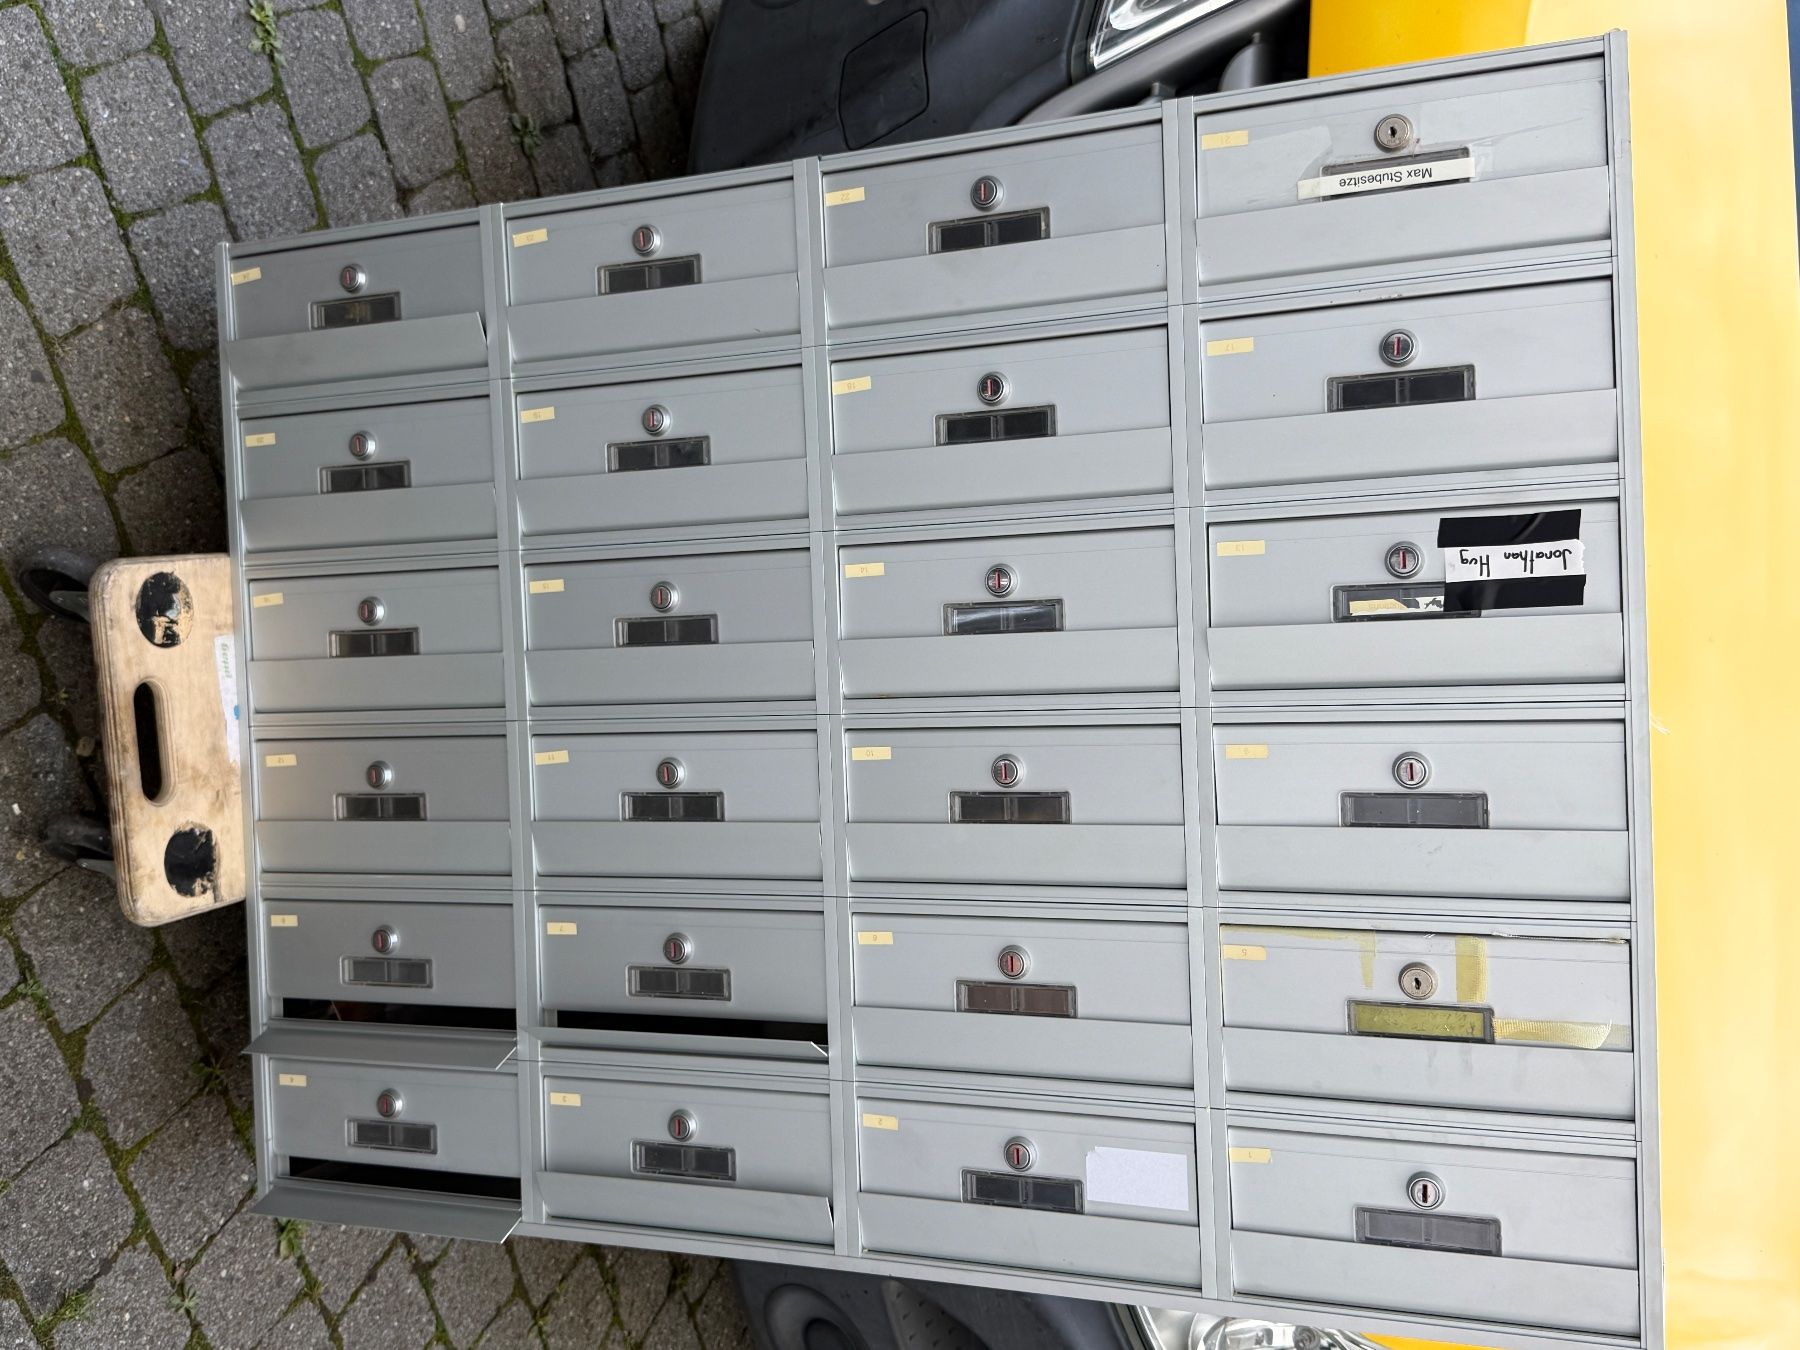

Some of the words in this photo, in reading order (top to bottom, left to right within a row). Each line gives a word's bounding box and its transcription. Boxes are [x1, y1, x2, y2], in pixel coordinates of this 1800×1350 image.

[1339, 172, 1402, 187] Stubesitze
[1407, 168, 1432, 178] Max
[1460, 549, 1491, 577] Hug
[1504, 549, 1572, 574] Jonathan
